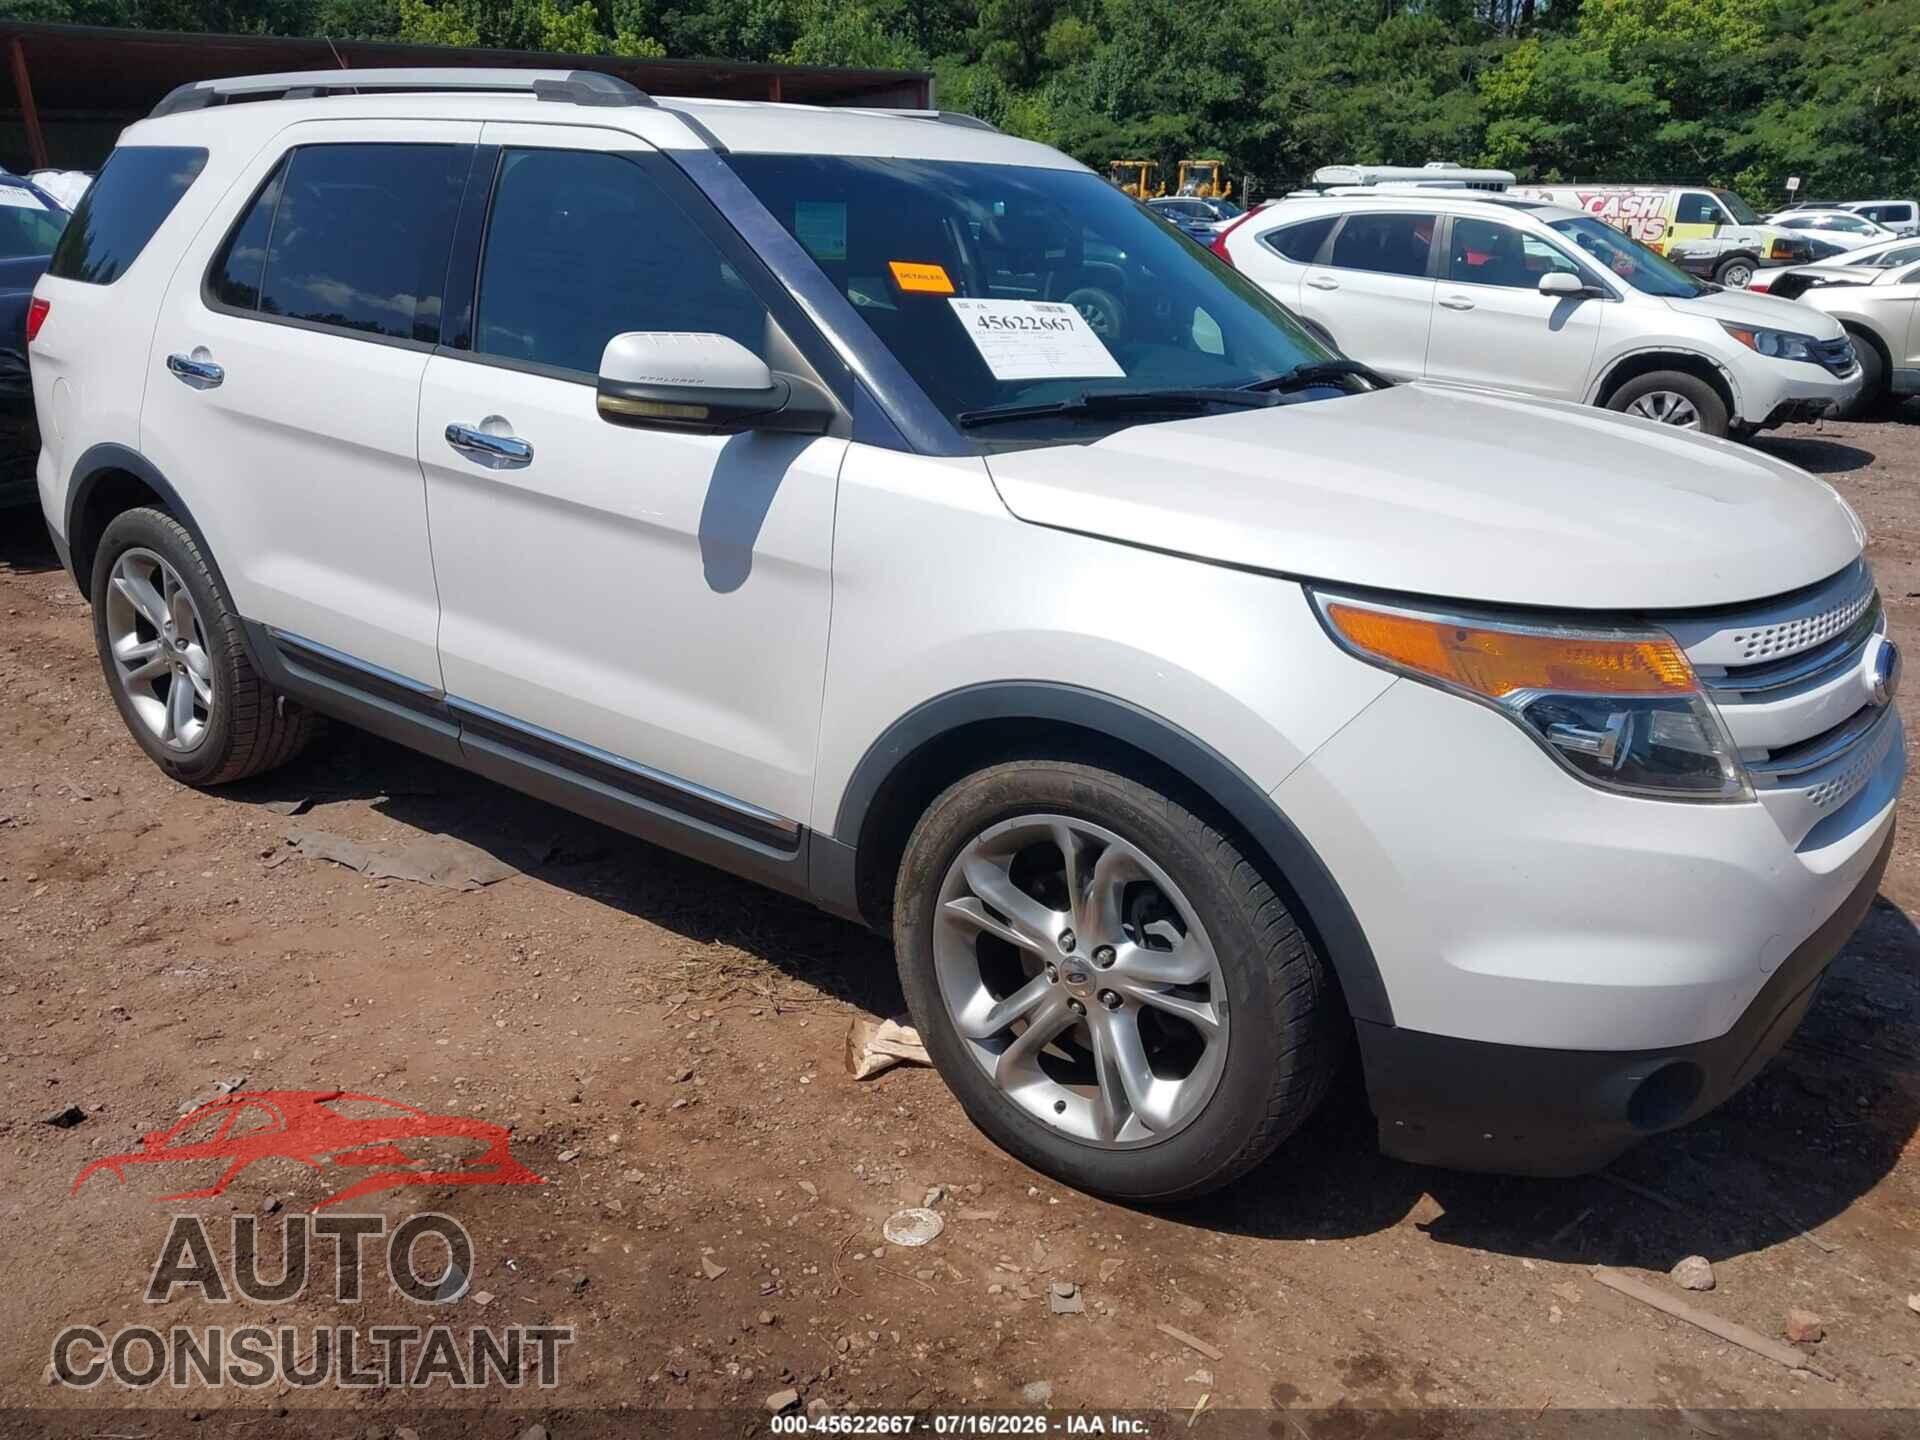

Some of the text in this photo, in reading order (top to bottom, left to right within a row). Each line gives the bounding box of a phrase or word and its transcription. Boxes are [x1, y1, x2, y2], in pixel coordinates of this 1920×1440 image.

[1584, 195, 1664, 217] CASH
[1605, 216, 1667, 241] ANS
[977, 315, 1074, 332] 45622667
